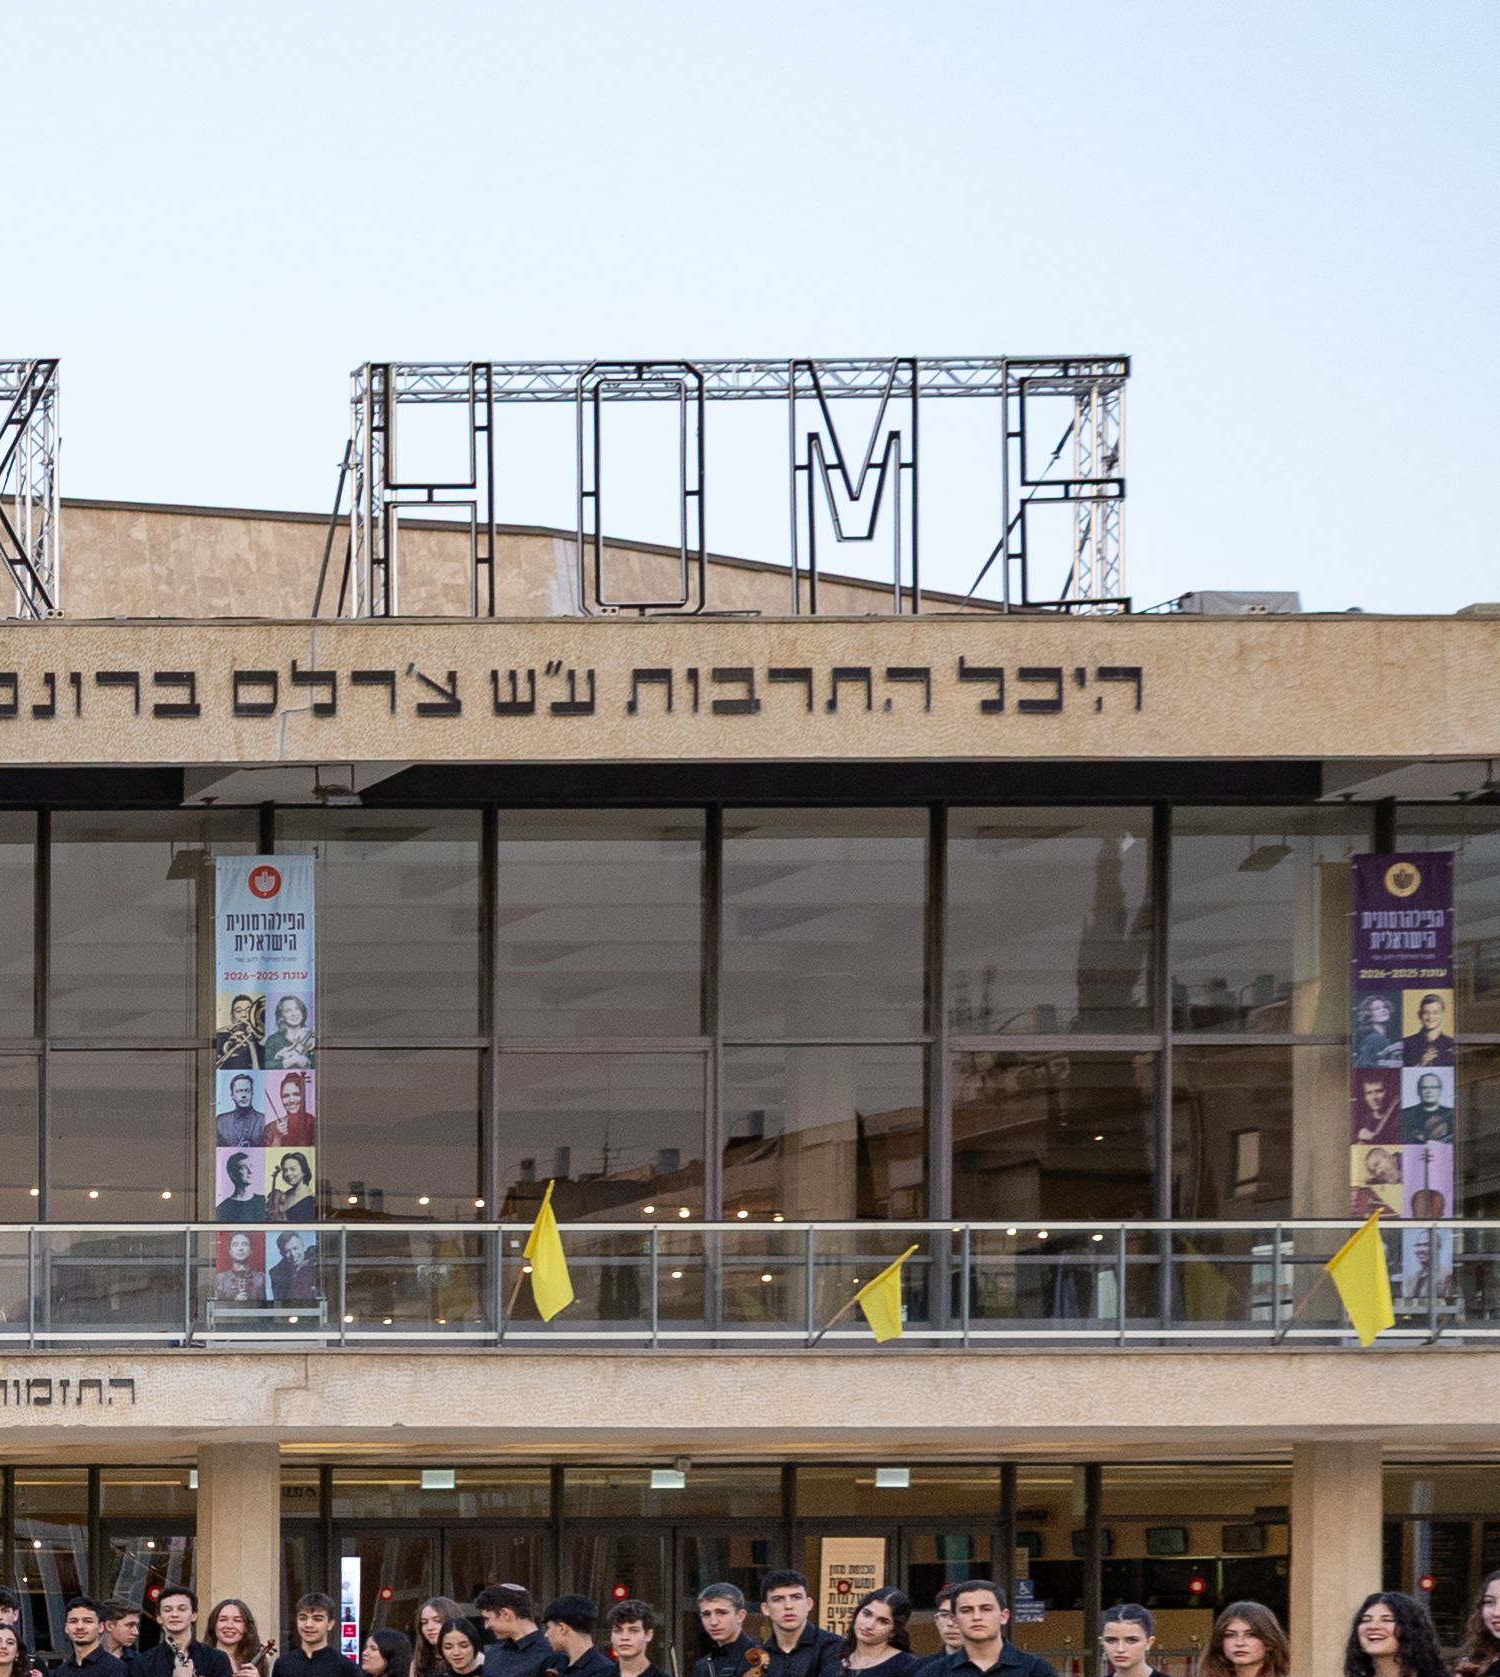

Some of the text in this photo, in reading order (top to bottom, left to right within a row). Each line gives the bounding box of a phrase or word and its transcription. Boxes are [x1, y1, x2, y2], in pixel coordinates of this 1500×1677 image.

[366, 355, 1131, 617] HOME
[626, 666, 931, 716] התרבות
[957, 656, 1143, 716] היכל
[226, 912, 305, 931] הפילהרמונית
[234, 933, 297, 952] הישראלית
[282, 971, 308, 980] עונת
